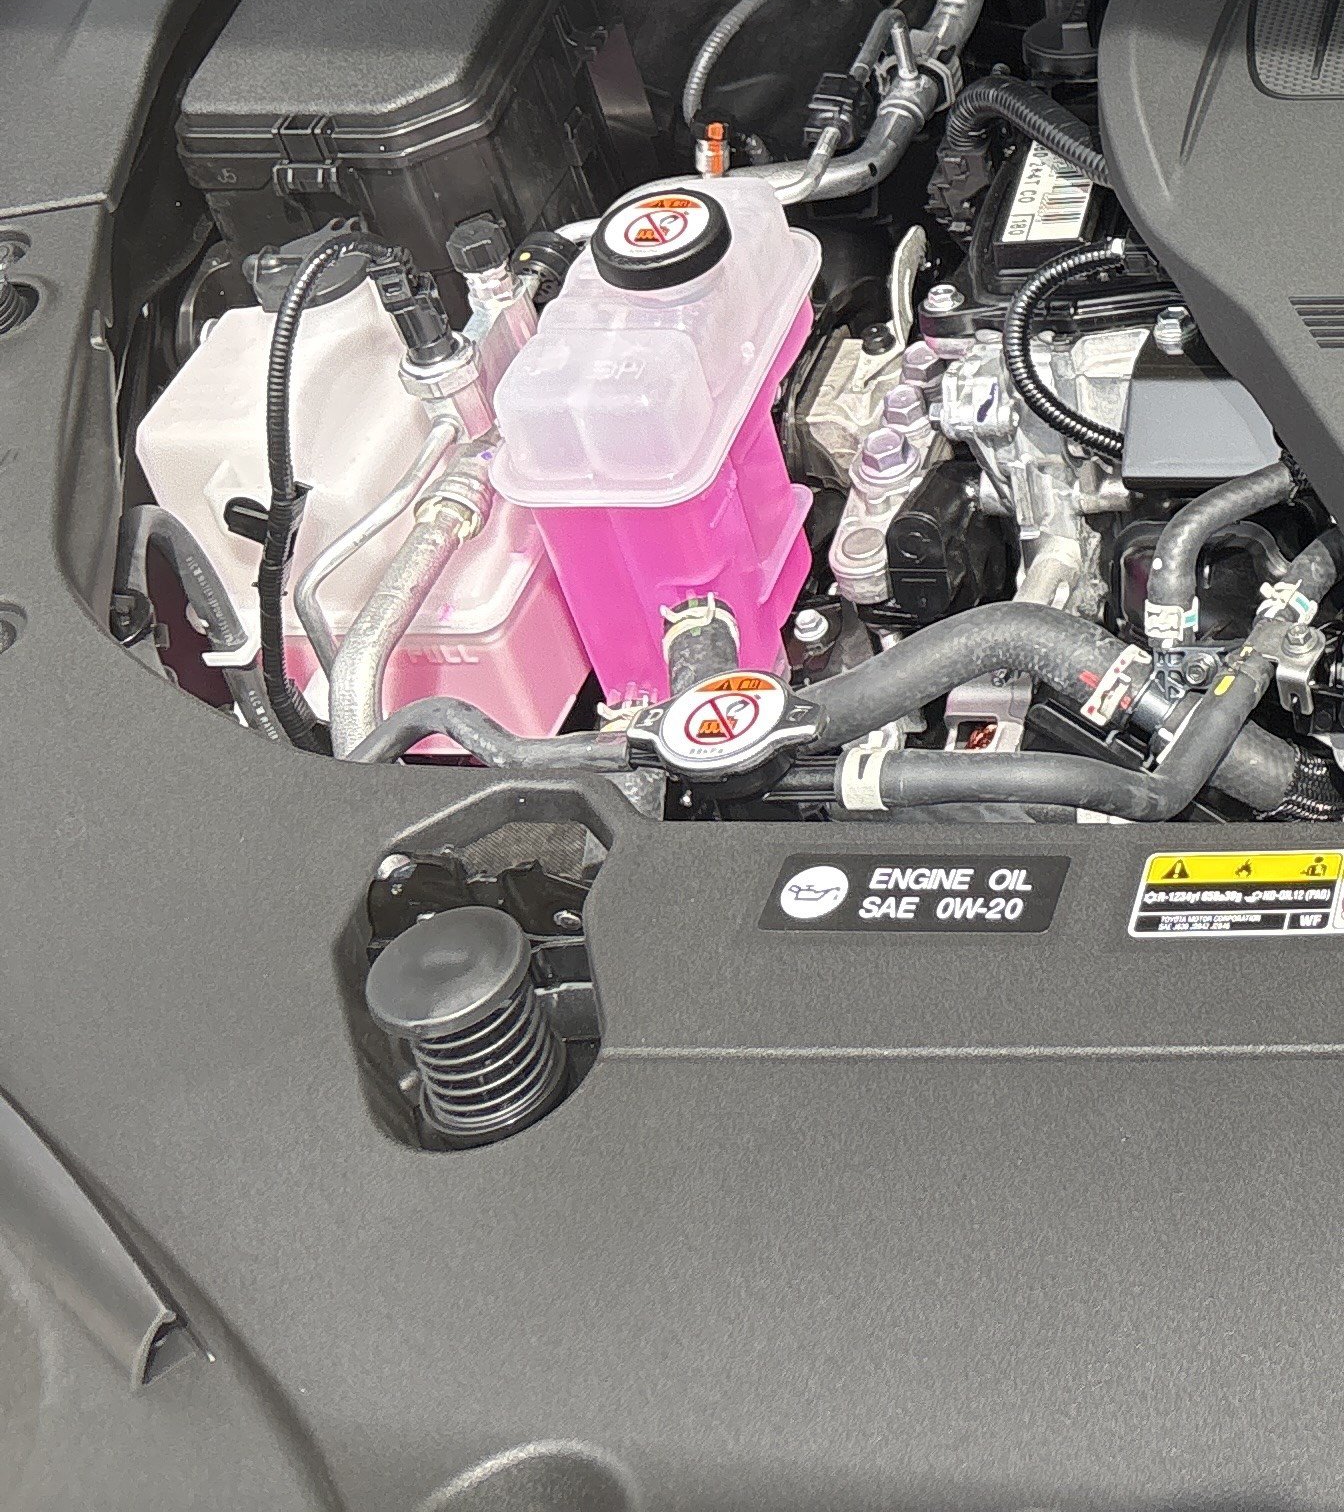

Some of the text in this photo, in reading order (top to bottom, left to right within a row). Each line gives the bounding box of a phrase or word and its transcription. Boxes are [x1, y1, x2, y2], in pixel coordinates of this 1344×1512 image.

[868, 867, 1033, 891] ENGINE OIL
[858, 895, 1024, 920] SAE 0W-20
[1299, 913, 1323, 927] WF
